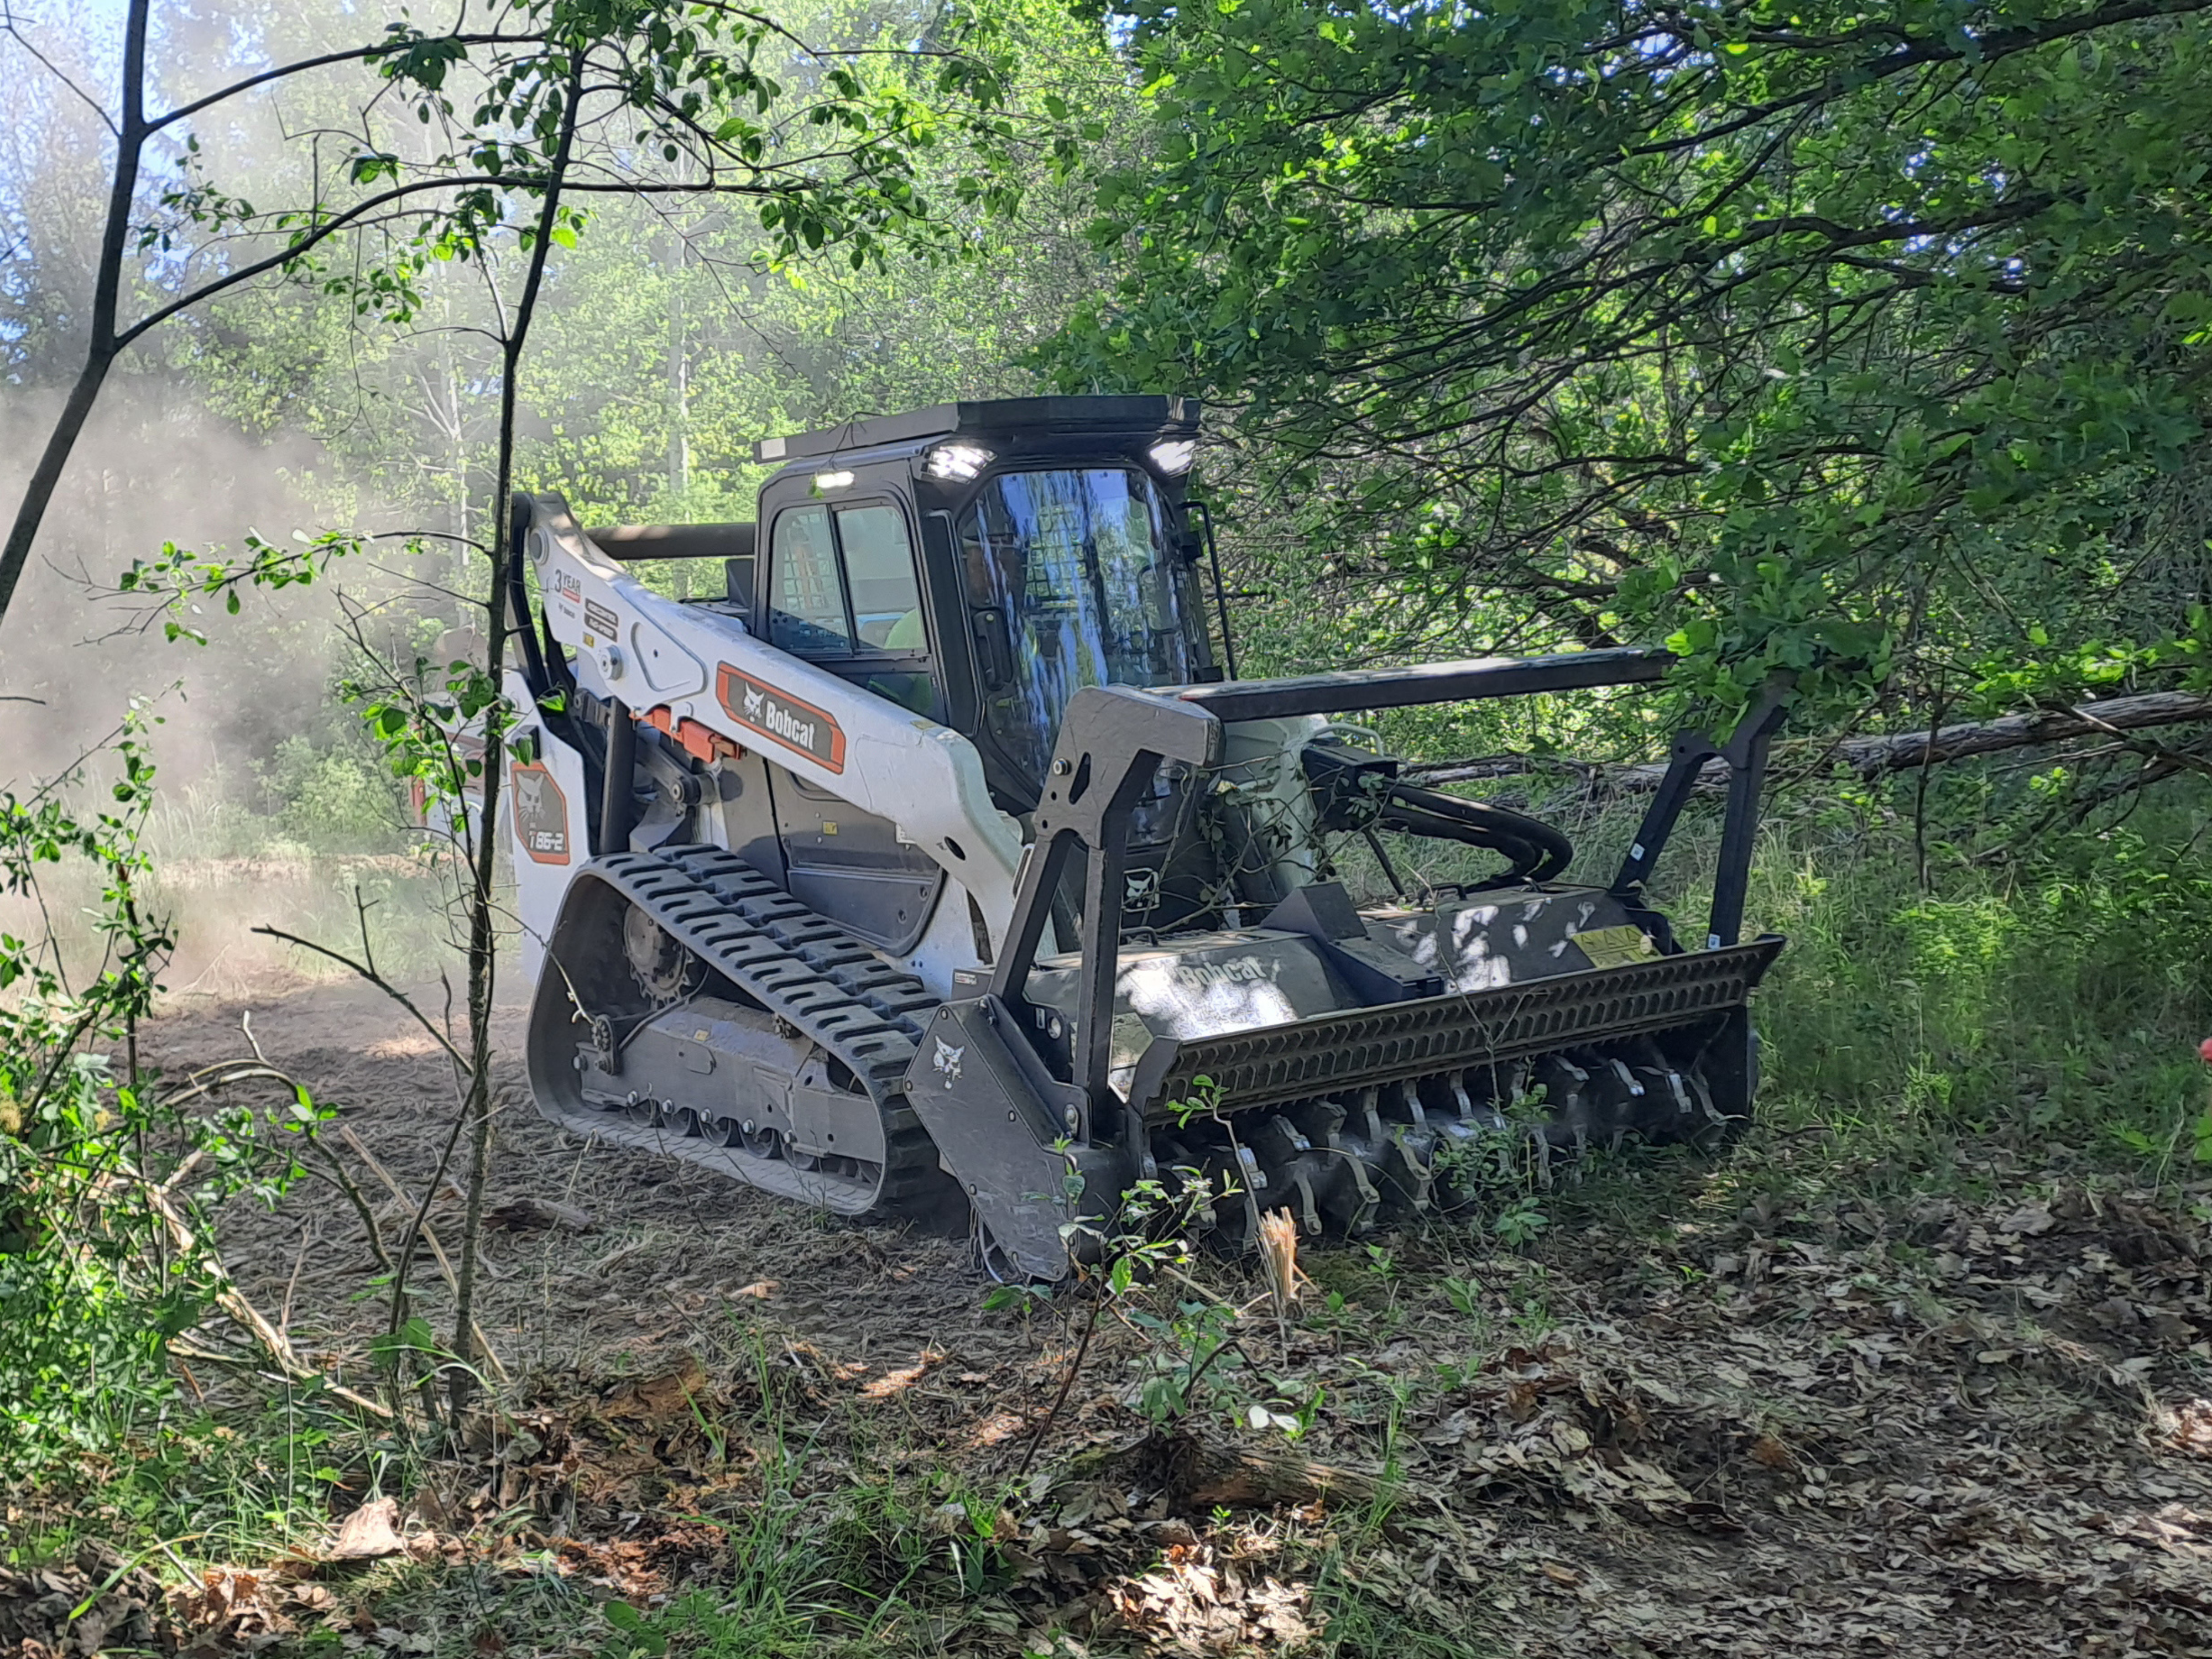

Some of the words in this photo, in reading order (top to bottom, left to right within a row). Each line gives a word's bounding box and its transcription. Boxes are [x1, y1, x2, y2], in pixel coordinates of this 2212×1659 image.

[555, 568, 562, 593] 3
[563, 572, 581, 594] YEAR
[765, 700, 815, 750] Bobcat
[1177, 956, 1267, 992] Bobcat
